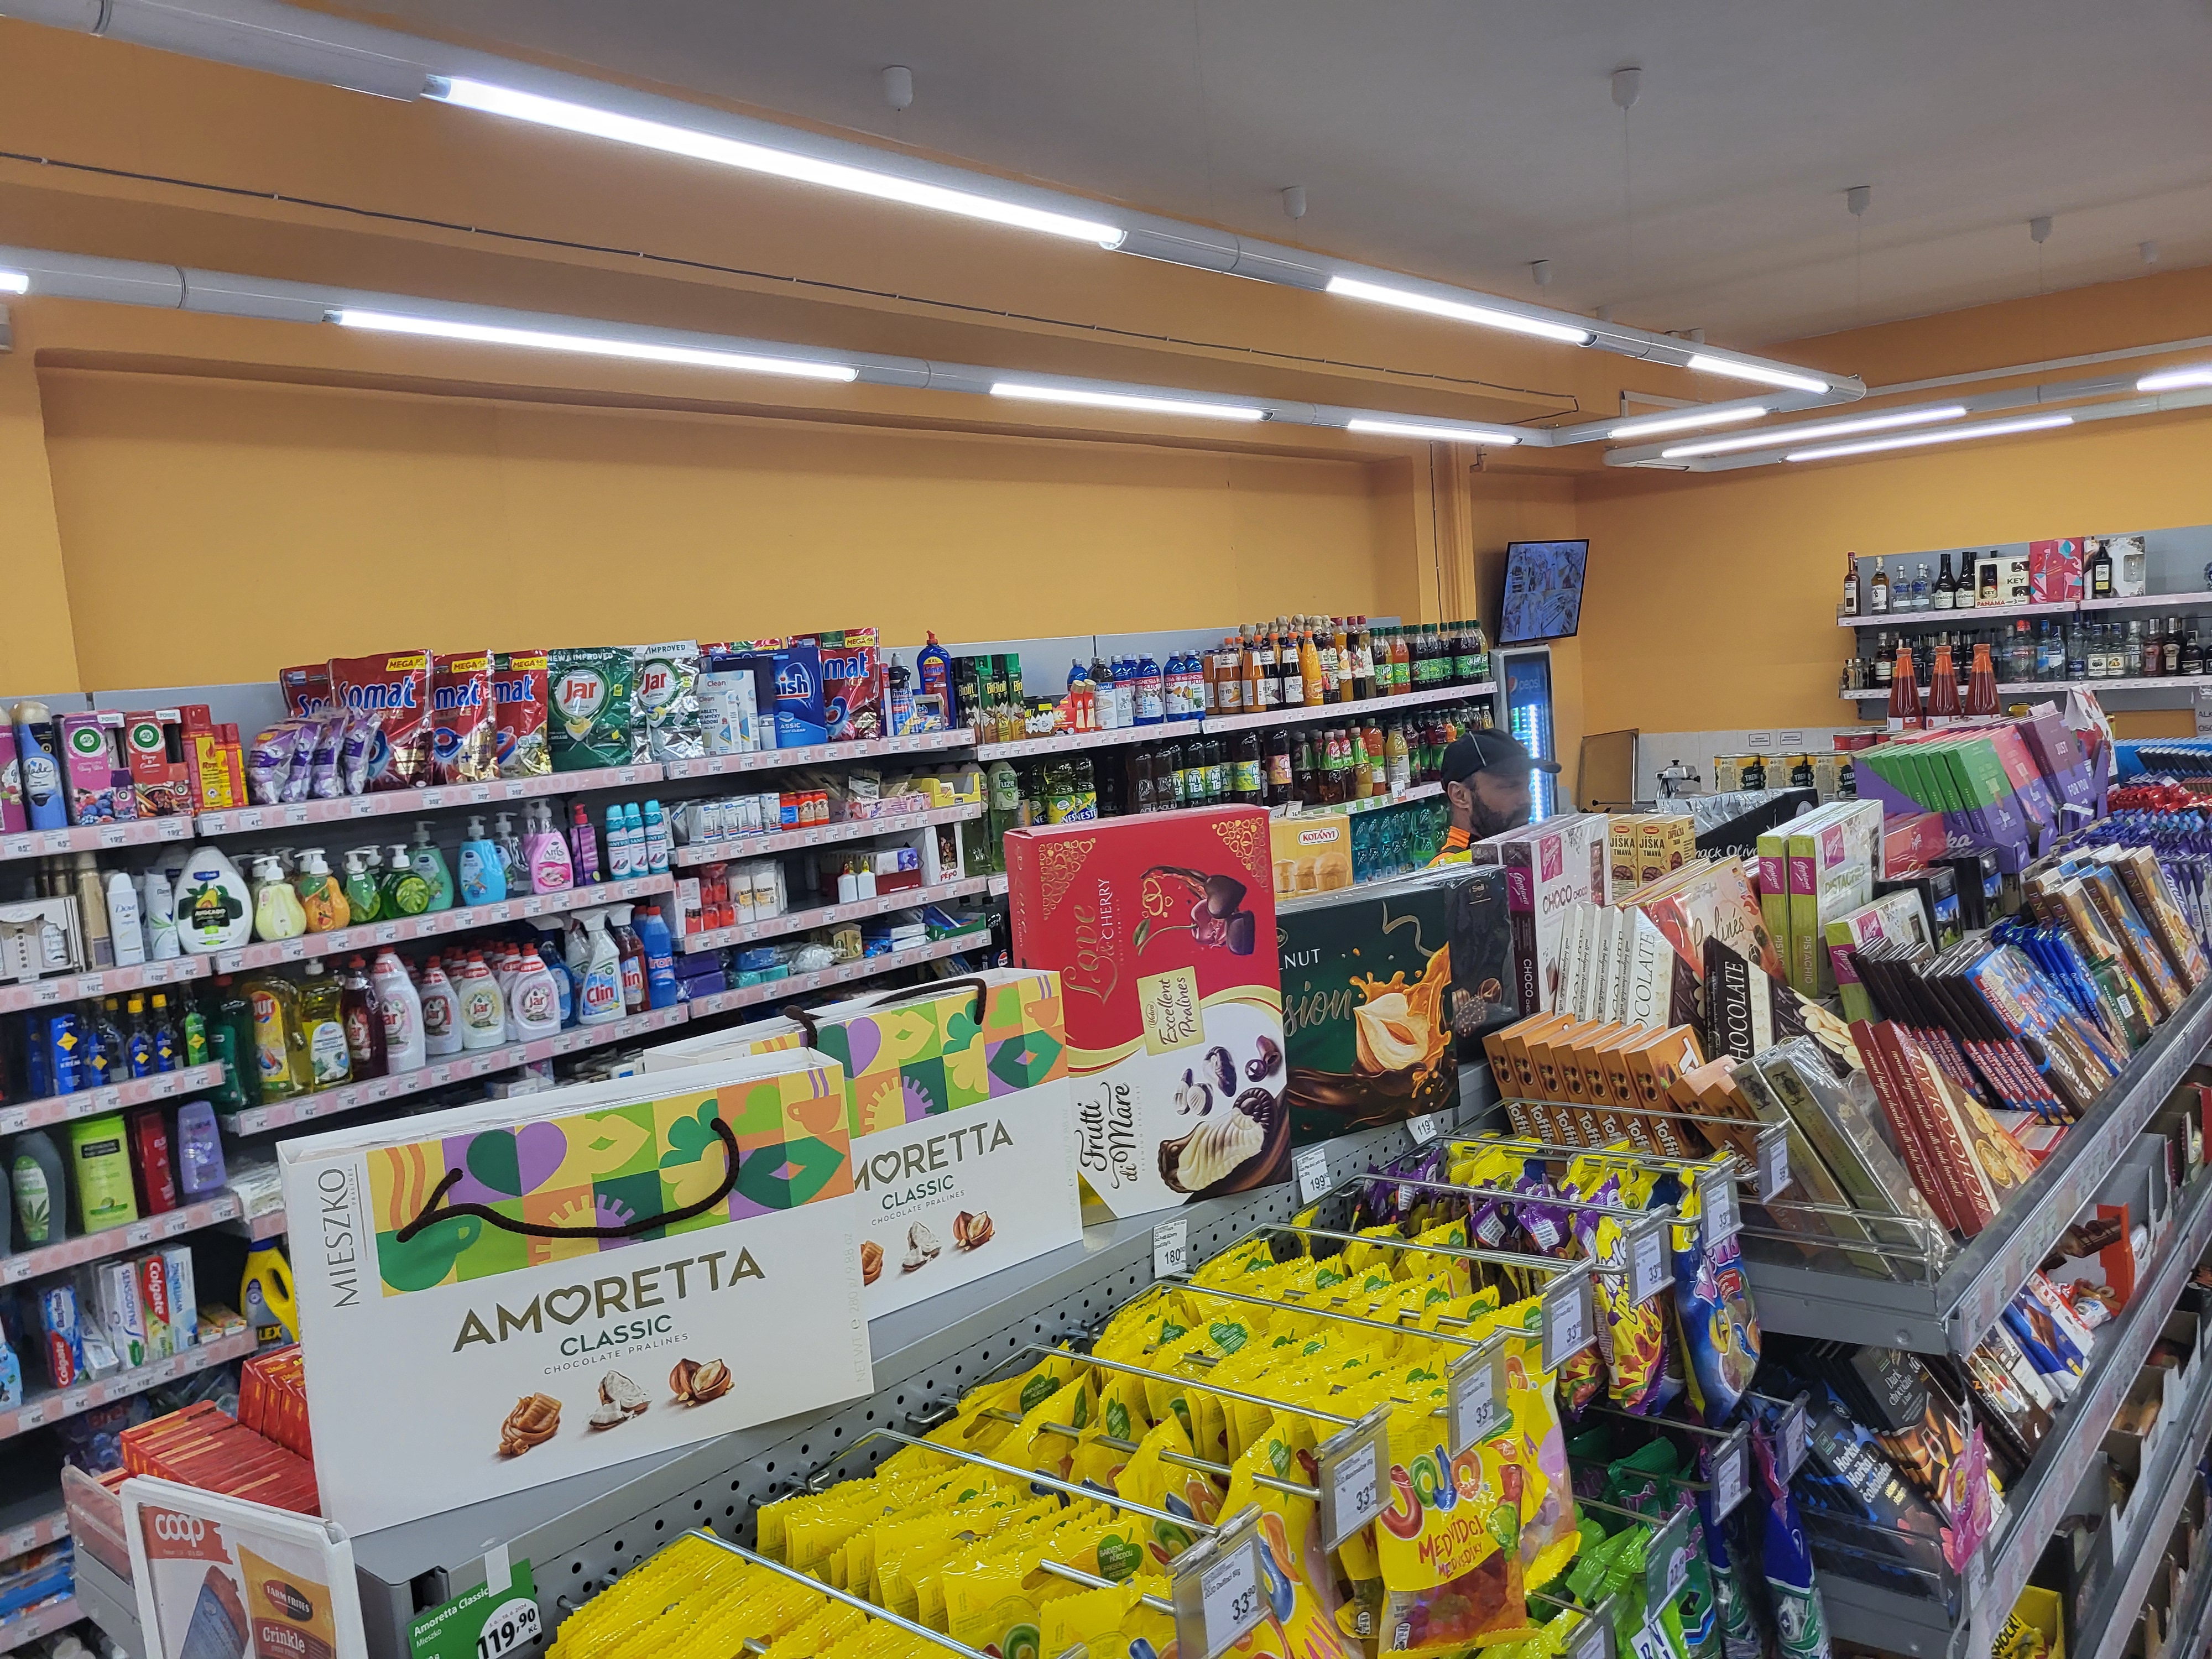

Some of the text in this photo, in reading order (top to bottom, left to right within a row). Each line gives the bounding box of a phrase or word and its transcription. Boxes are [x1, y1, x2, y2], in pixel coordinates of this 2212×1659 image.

[389, 659, 414, 668] MEGA
[513, 659, 536, 667] MEGA
[572, 651, 614, 661] IMPROVED
[648, 644, 686, 654] IMPROVED
[453, 661, 477, 671] MEGA
[823, 650, 869, 680] mat
[339, 676, 418, 709] Somat
[435, 678, 482, 711] mat
[495, 674, 535, 703] mat
[564, 680, 597, 704] Jar
[642, 672, 667, 695] Jar
[775, 672, 809, 695] nish
[1518, 676, 1541, 692] pepsi
[1188, 774, 1201, 785] MY
[1188, 783, 1203, 793] TEA
[1032, 813, 1047, 824] NES
[1061, 811, 1076, 823] NES
[1076, 808, 1097, 821] NESTE
[1302, 828, 1338, 842] KOTÁNYI
[1610, 834, 1635, 848] JÍŠKA
[1639, 835, 1665, 849] JÍŠKA
[1613, 848, 1632, 857] TMAVÁ
[1643, 849, 1662, 857] TMAVÁ
[1695, 846, 1722, 859] nack
[1097, 878, 1115, 939] CHERRY
[1542, 884, 1572, 915] CHOCO
[1774, 935, 1785, 969] PISTAC
[1802, 936, 1813, 985] PISTACHIO
[586, 983, 613, 1004] Clin
[623, 971, 640, 988] lin
[1524, 958, 1534, 998] CHOCO
[383, 1011, 399, 1026] ar
[1158, 978, 1178, 1045] Excellent
[1178, 977, 1197, 1039] Pralines
[1282, 980, 1353, 1038] sion
[1724, 961, 1751, 1065] HOCOLATE
[1865, 1049, 1881, 1078] caramel
[1875, 1074, 1891, 1099] belgian
[1887, 1099, 1906, 1129] chocolate
[1891, 1050, 1910, 1077] caramel
[1902, 1076, 1918, 1100] belgian
[1914, 1100, 1934, 1131] chocolate
[1507, 1102, 1531, 1135] Toffi
[1555, 1109, 1578, 1147] Toffif
[1074, 1098, 1107, 1172] Frutti
[1654, 1118, 1681, 1157] Toffif
[854, 1118, 1014, 1192] MORETTA
[881, 1175, 954, 1210] CLASSIC
[870, 1190, 966, 1227] CHOCOLATE PRALINES
[317, 1167, 361, 1308] MIESZKO
[148, 1261, 165, 1317] Colgate
[452, 1245, 766, 1353] AMORETTA
[560, 1313, 673, 1357] CLASSIC
[55, 1341, 74, 1386] Colgate
[544, 1332, 690, 1375] CHOCOLATE PRALINES
[1885, 1367, 1903, 1390] Dark
[1888, 1374, 1914, 1407] chocolate
[1861, 1462, 1893, 1504] čokoláda
[155, 1513, 205, 1548] coop
[266, 1584, 311, 1615] FARM FRITES
[413, 1588, 489, 1637] Amoretta Classic
[1231, 1592, 1250, 1620] 33
[263, 1625, 306, 1655] Crinkle
[415, 1627, 442, 1649] Mieszko
[1991, 1614, 2022, 1658] HOCK!
